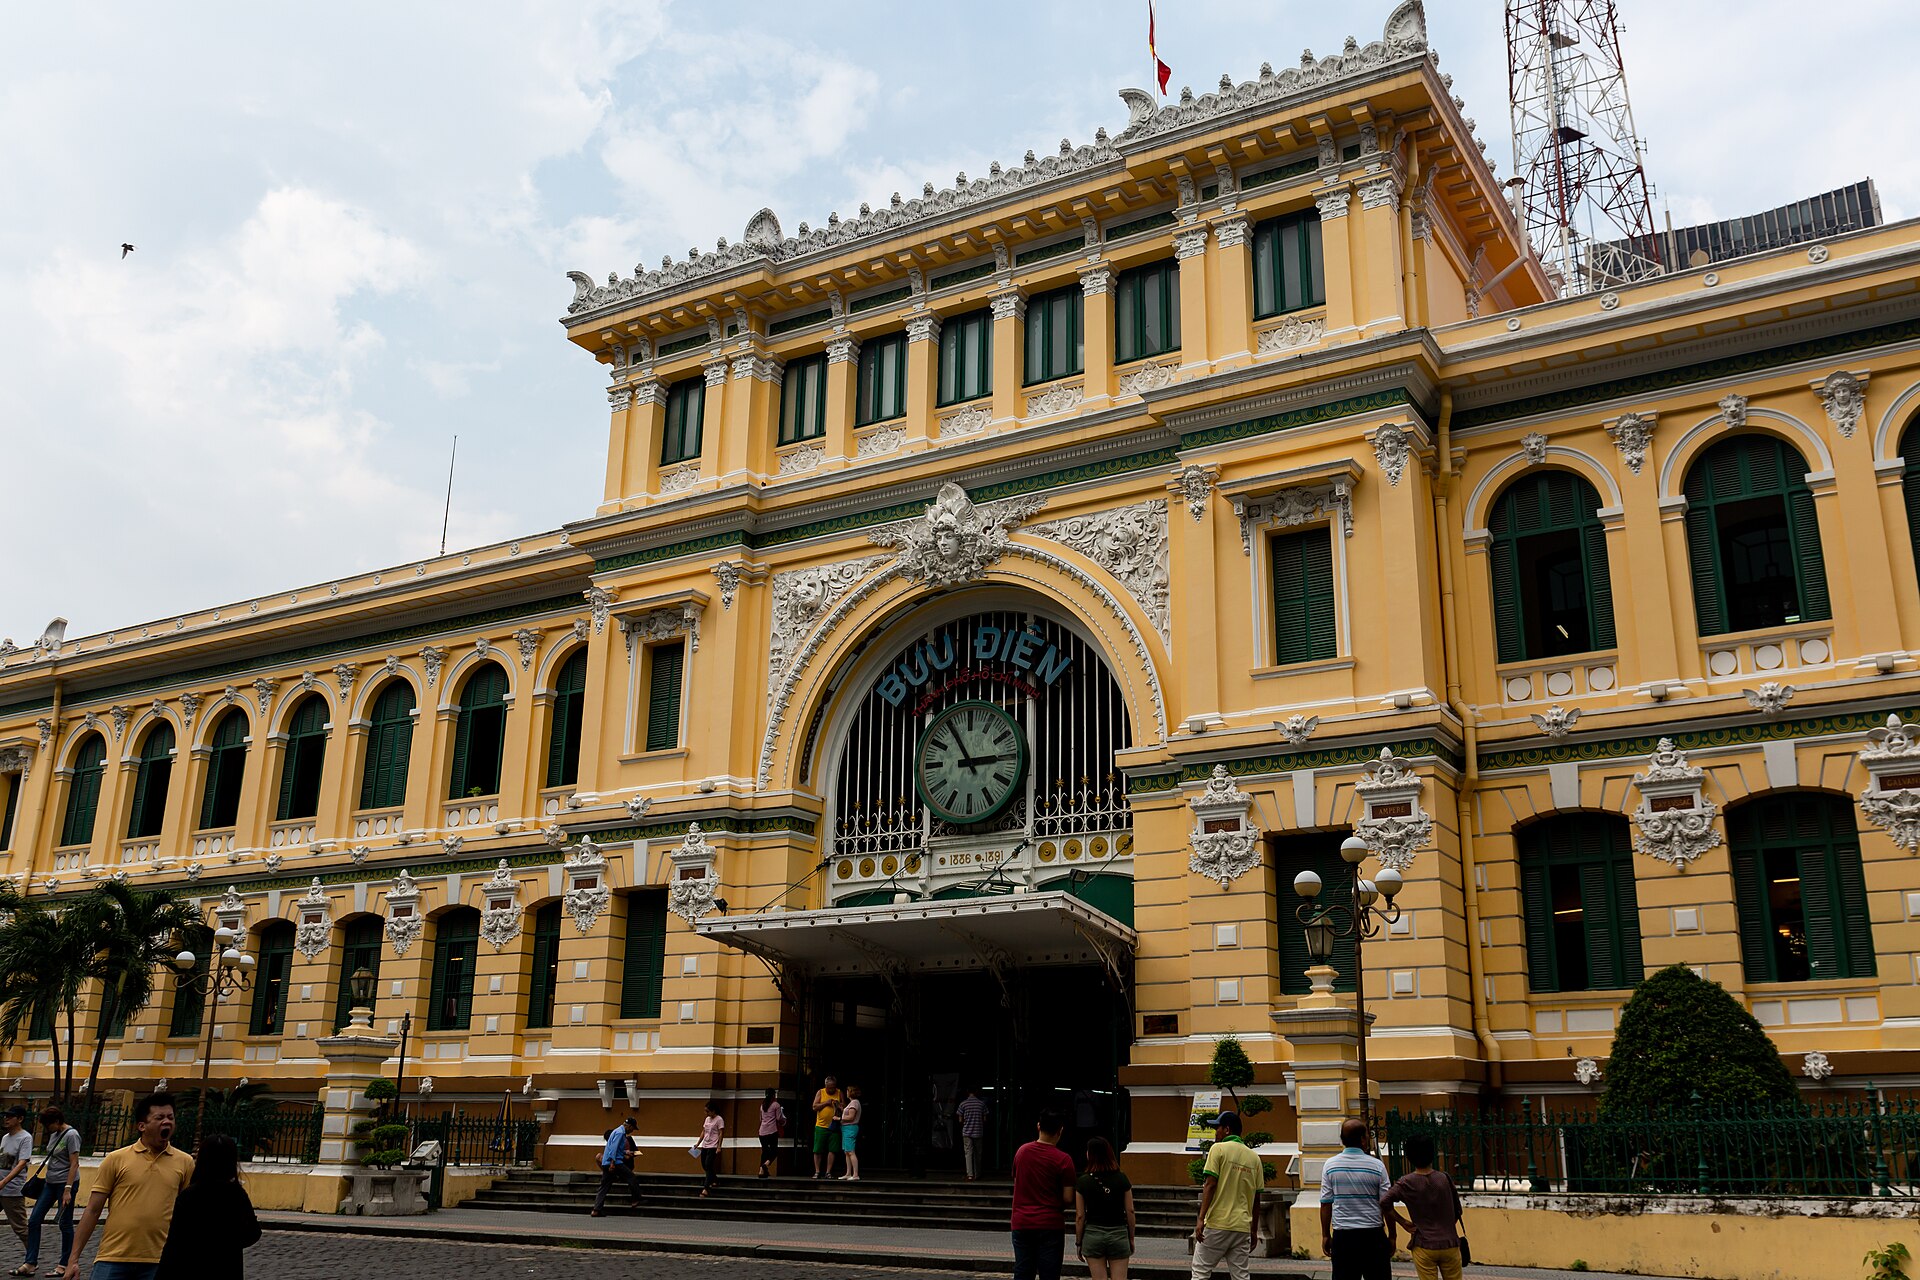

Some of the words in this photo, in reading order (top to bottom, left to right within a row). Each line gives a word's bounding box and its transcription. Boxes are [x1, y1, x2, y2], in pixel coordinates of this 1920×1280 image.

[974, 624, 1072, 687] ĐIỆN
[1012, 679, 1041, 699] MINH
[949, 853, 972, 866] 1886
[985, 850, 1004, 863] 1891
